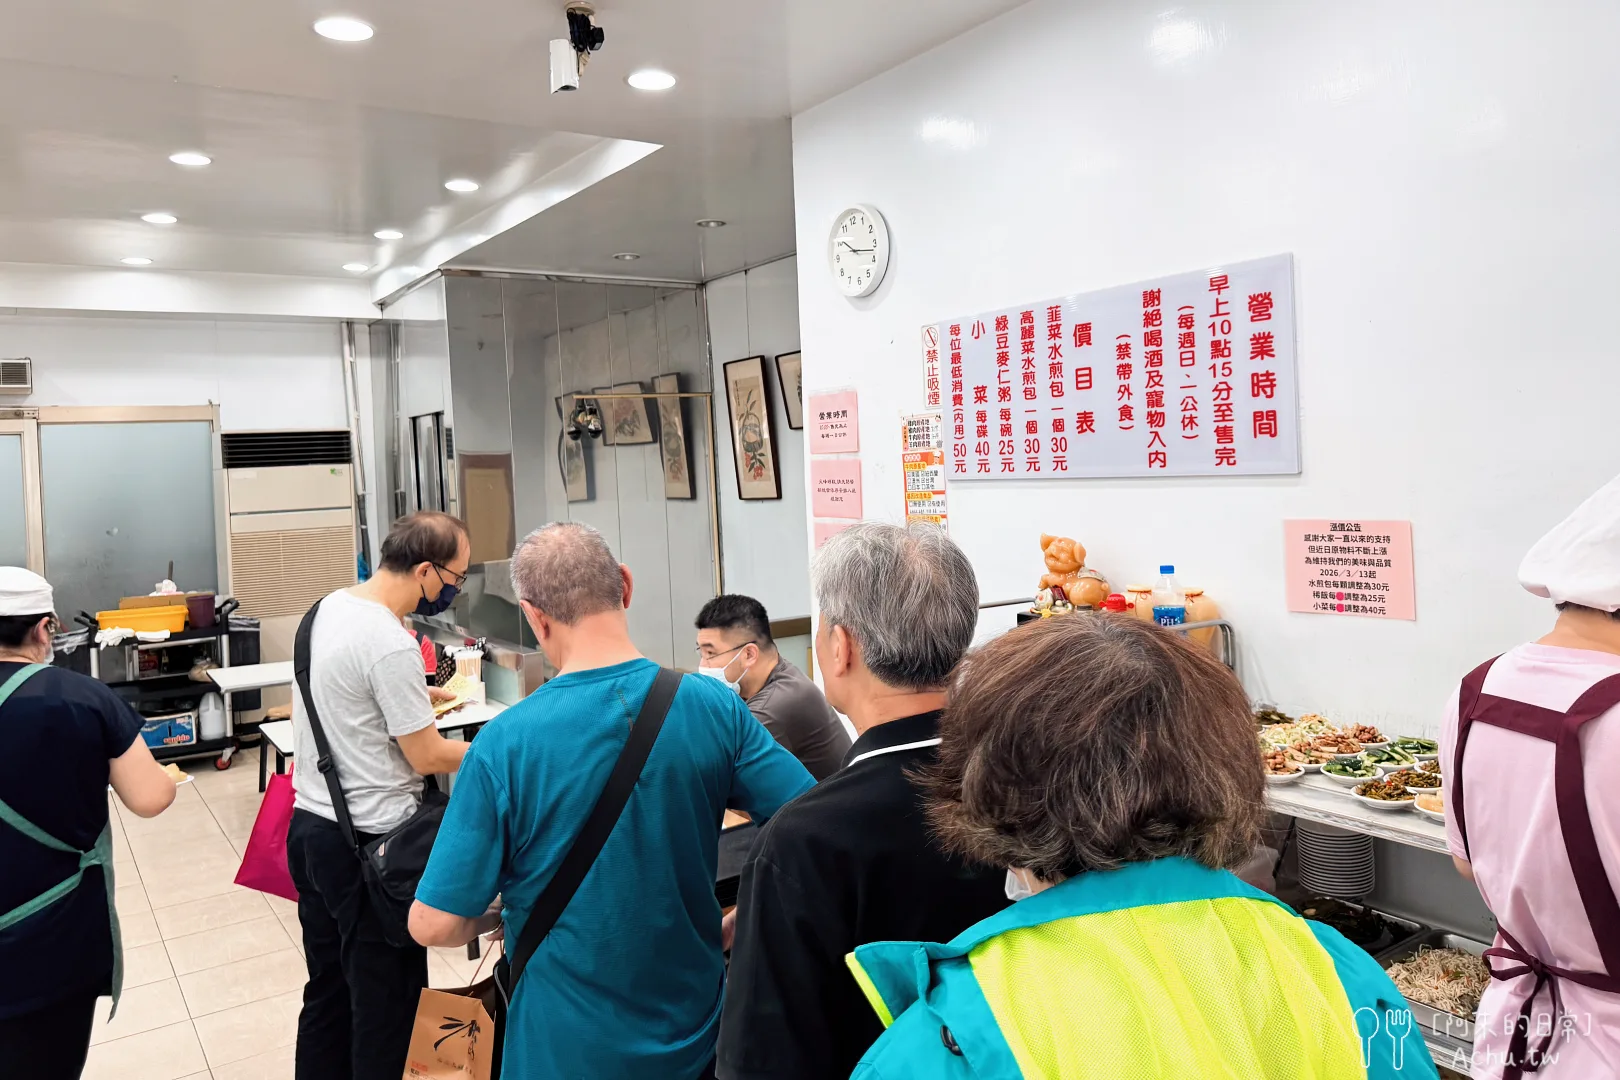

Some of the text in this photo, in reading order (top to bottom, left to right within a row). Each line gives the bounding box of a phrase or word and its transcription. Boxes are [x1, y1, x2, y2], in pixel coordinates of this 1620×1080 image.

[850, 216, 856, 226] 12
[842, 225, 848, 233] 11
[868, 224, 874, 234] 2
[872, 238, 877, 248] 3
[836, 254, 840, 263] 9
[872, 255, 876, 263] 4
[840, 268, 844, 276] 8
[866, 269, 871, 278] 5
[848, 276, 852, 284] 7
[858, 277, 862, 285] 6
[1247, 291, 1278, 439] 營業時間
[1207, 274, 1237, 467] 早上10點15分至售完
[925, 349, 941, 406] 禁止吸煙
[1072, 322, 1096, 435] 價目表
[1142, 288, 1167, 469] 謝絕喝酒及寵物入內
[1330, 523, 1361, 532] 漲價公告
[1303, 534, 1391, 544] 感謝大家一直以來的支持
[1308, 545, 1388, 556] 但近日原物料不斷上漲
[1305, 556, 1391, 567] 為維持我們的美味與品質
[1309, 580, 1390, 591] 水煎包每顆調整為30元
[1313, 591, 1386, 603] 稀飯每調整為25元
[1313, 603, 1386, 614] 小菜每調整為40元
